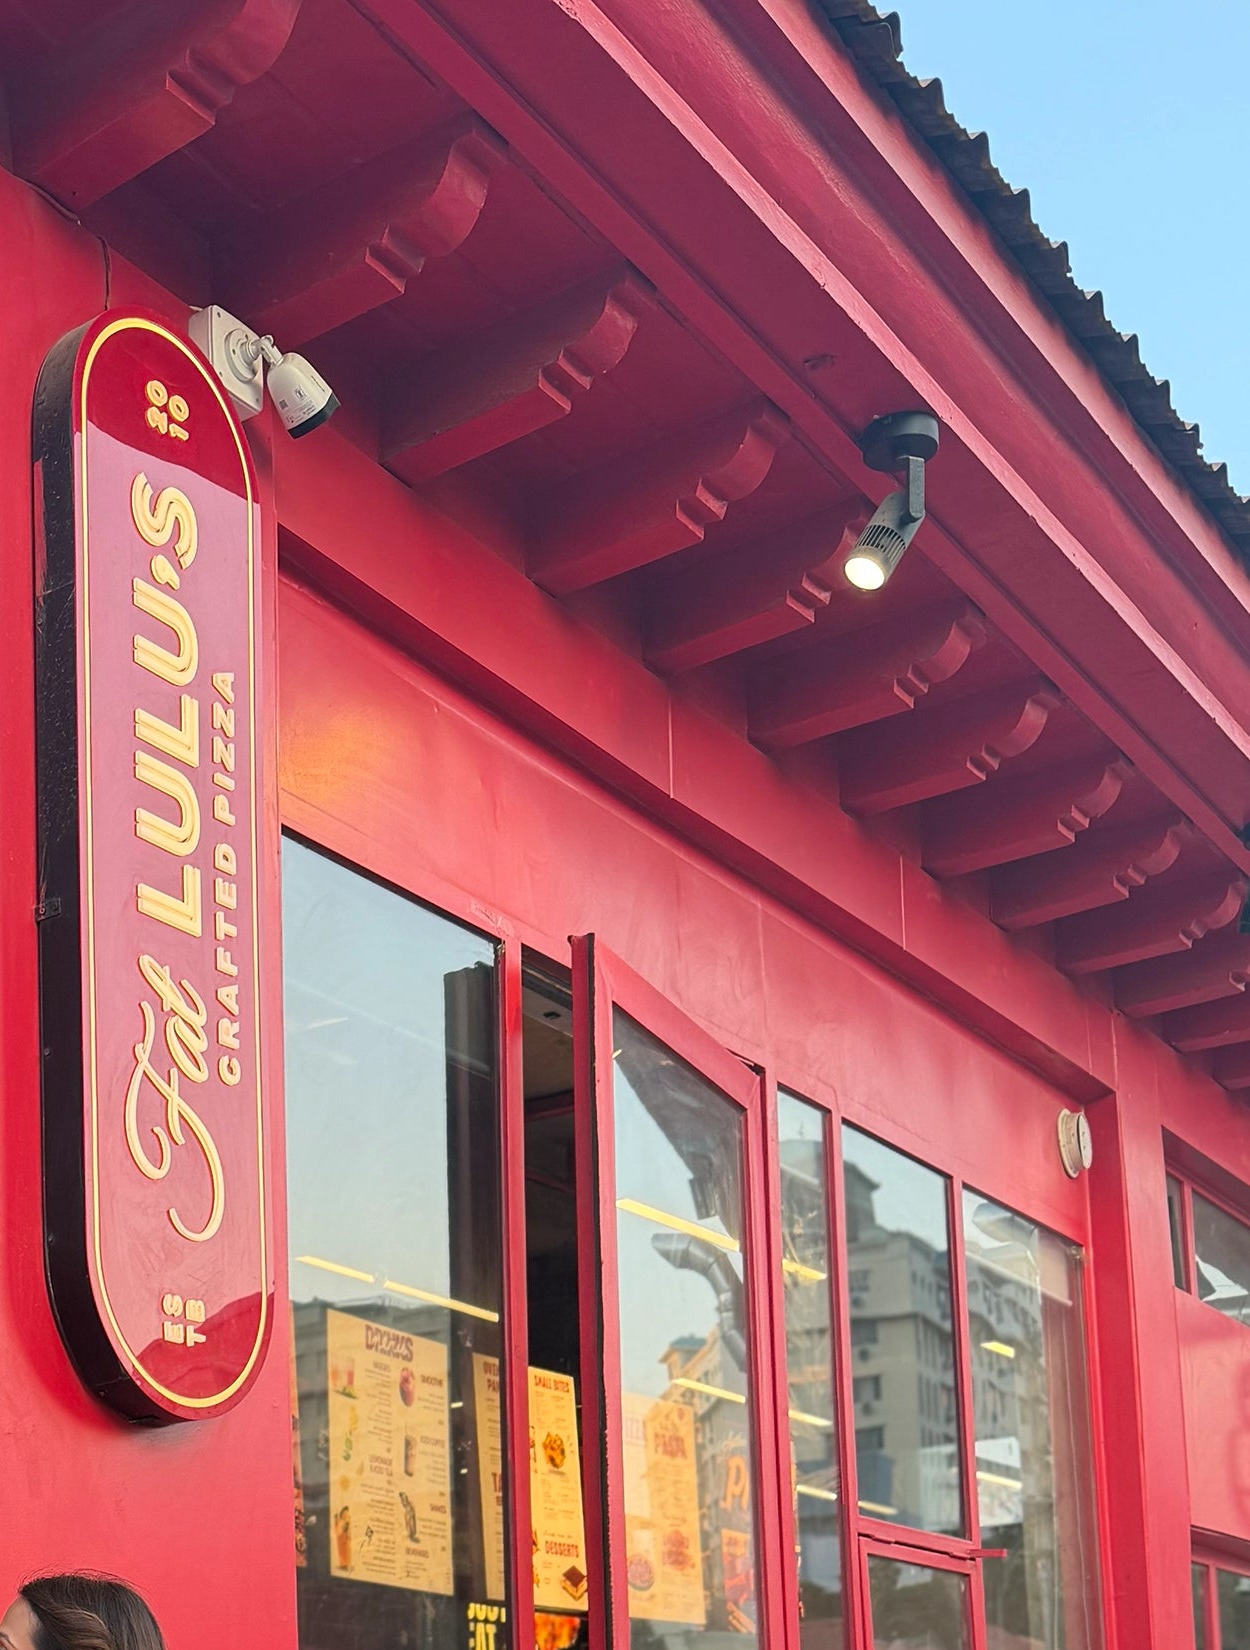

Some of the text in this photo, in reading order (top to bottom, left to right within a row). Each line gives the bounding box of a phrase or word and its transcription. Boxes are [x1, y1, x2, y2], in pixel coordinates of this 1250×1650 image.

[145, 379, 169, 435] 20
[168, 394, 190, 442] 10
[124, 471, 225, 1243] Fat LULU'S
[212, 671, 242, 1087] CRAFTED PIZZA
[162, 1292, 184, 1345] ES
[185, 1297, 207, 1348] TB
